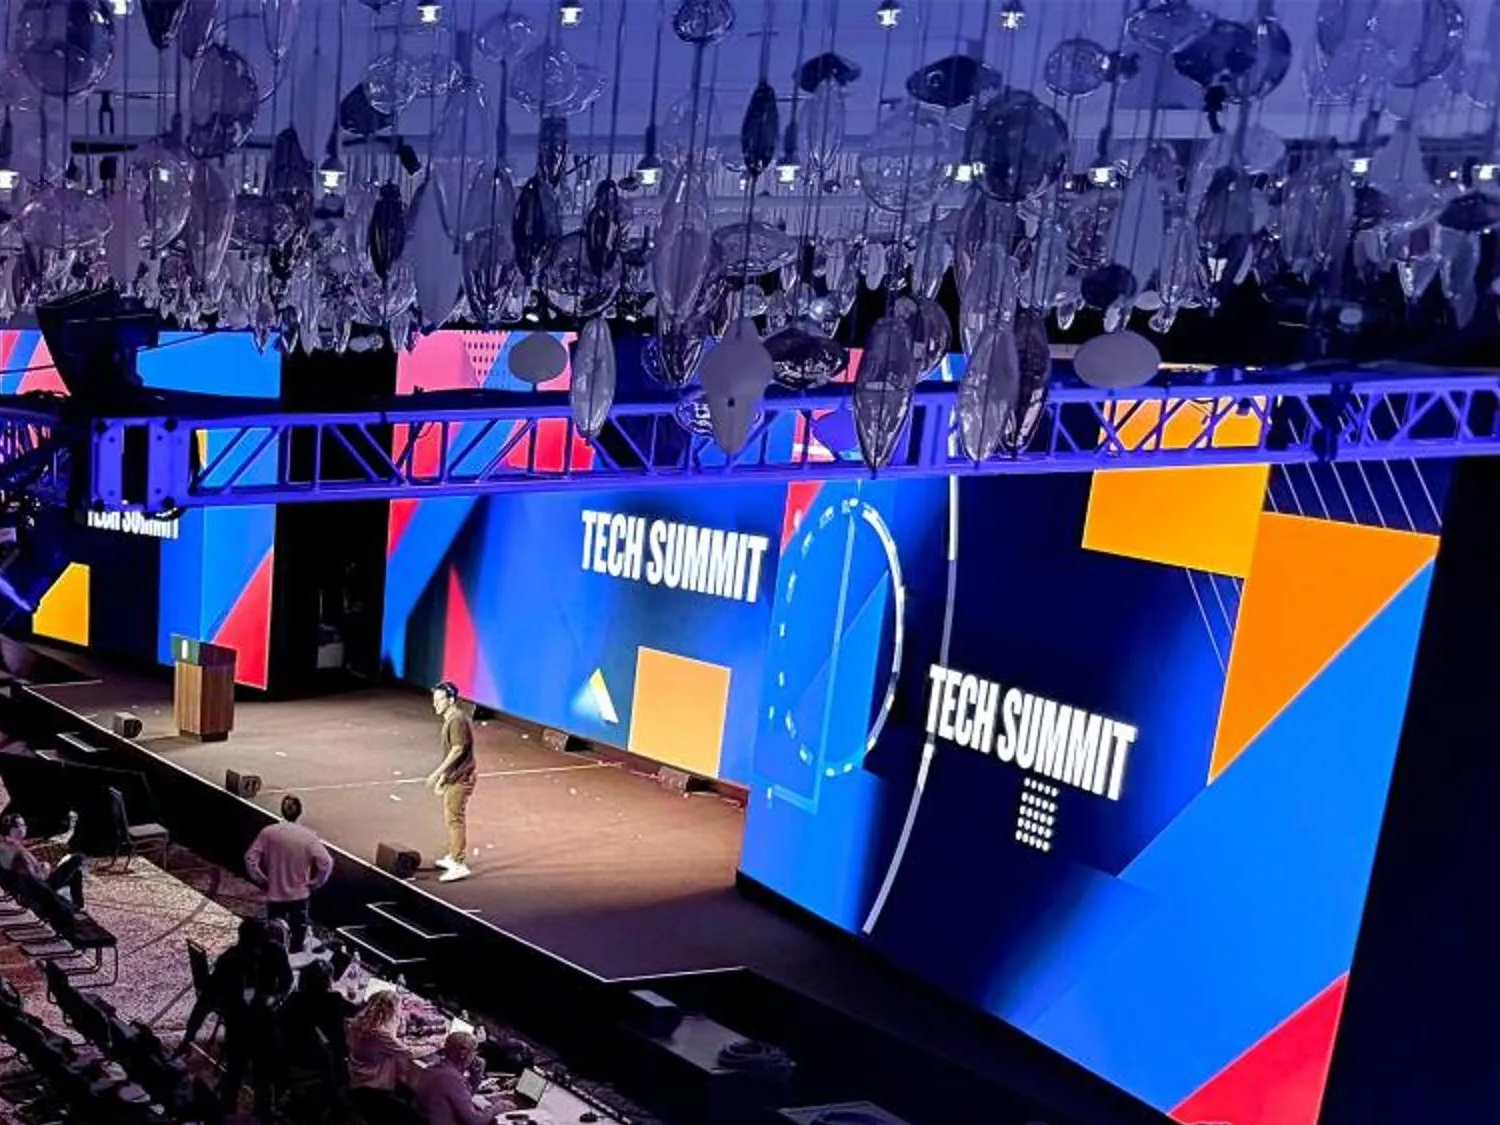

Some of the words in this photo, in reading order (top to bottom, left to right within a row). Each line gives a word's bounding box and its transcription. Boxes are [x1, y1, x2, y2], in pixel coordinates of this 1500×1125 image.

[581, 509, 646, 580] TECH
[646, 519, 769, 603] SUMMIT
[926, 664, 1000, 754] TECH
[997, 688, 1138, 801] SUMMIT
